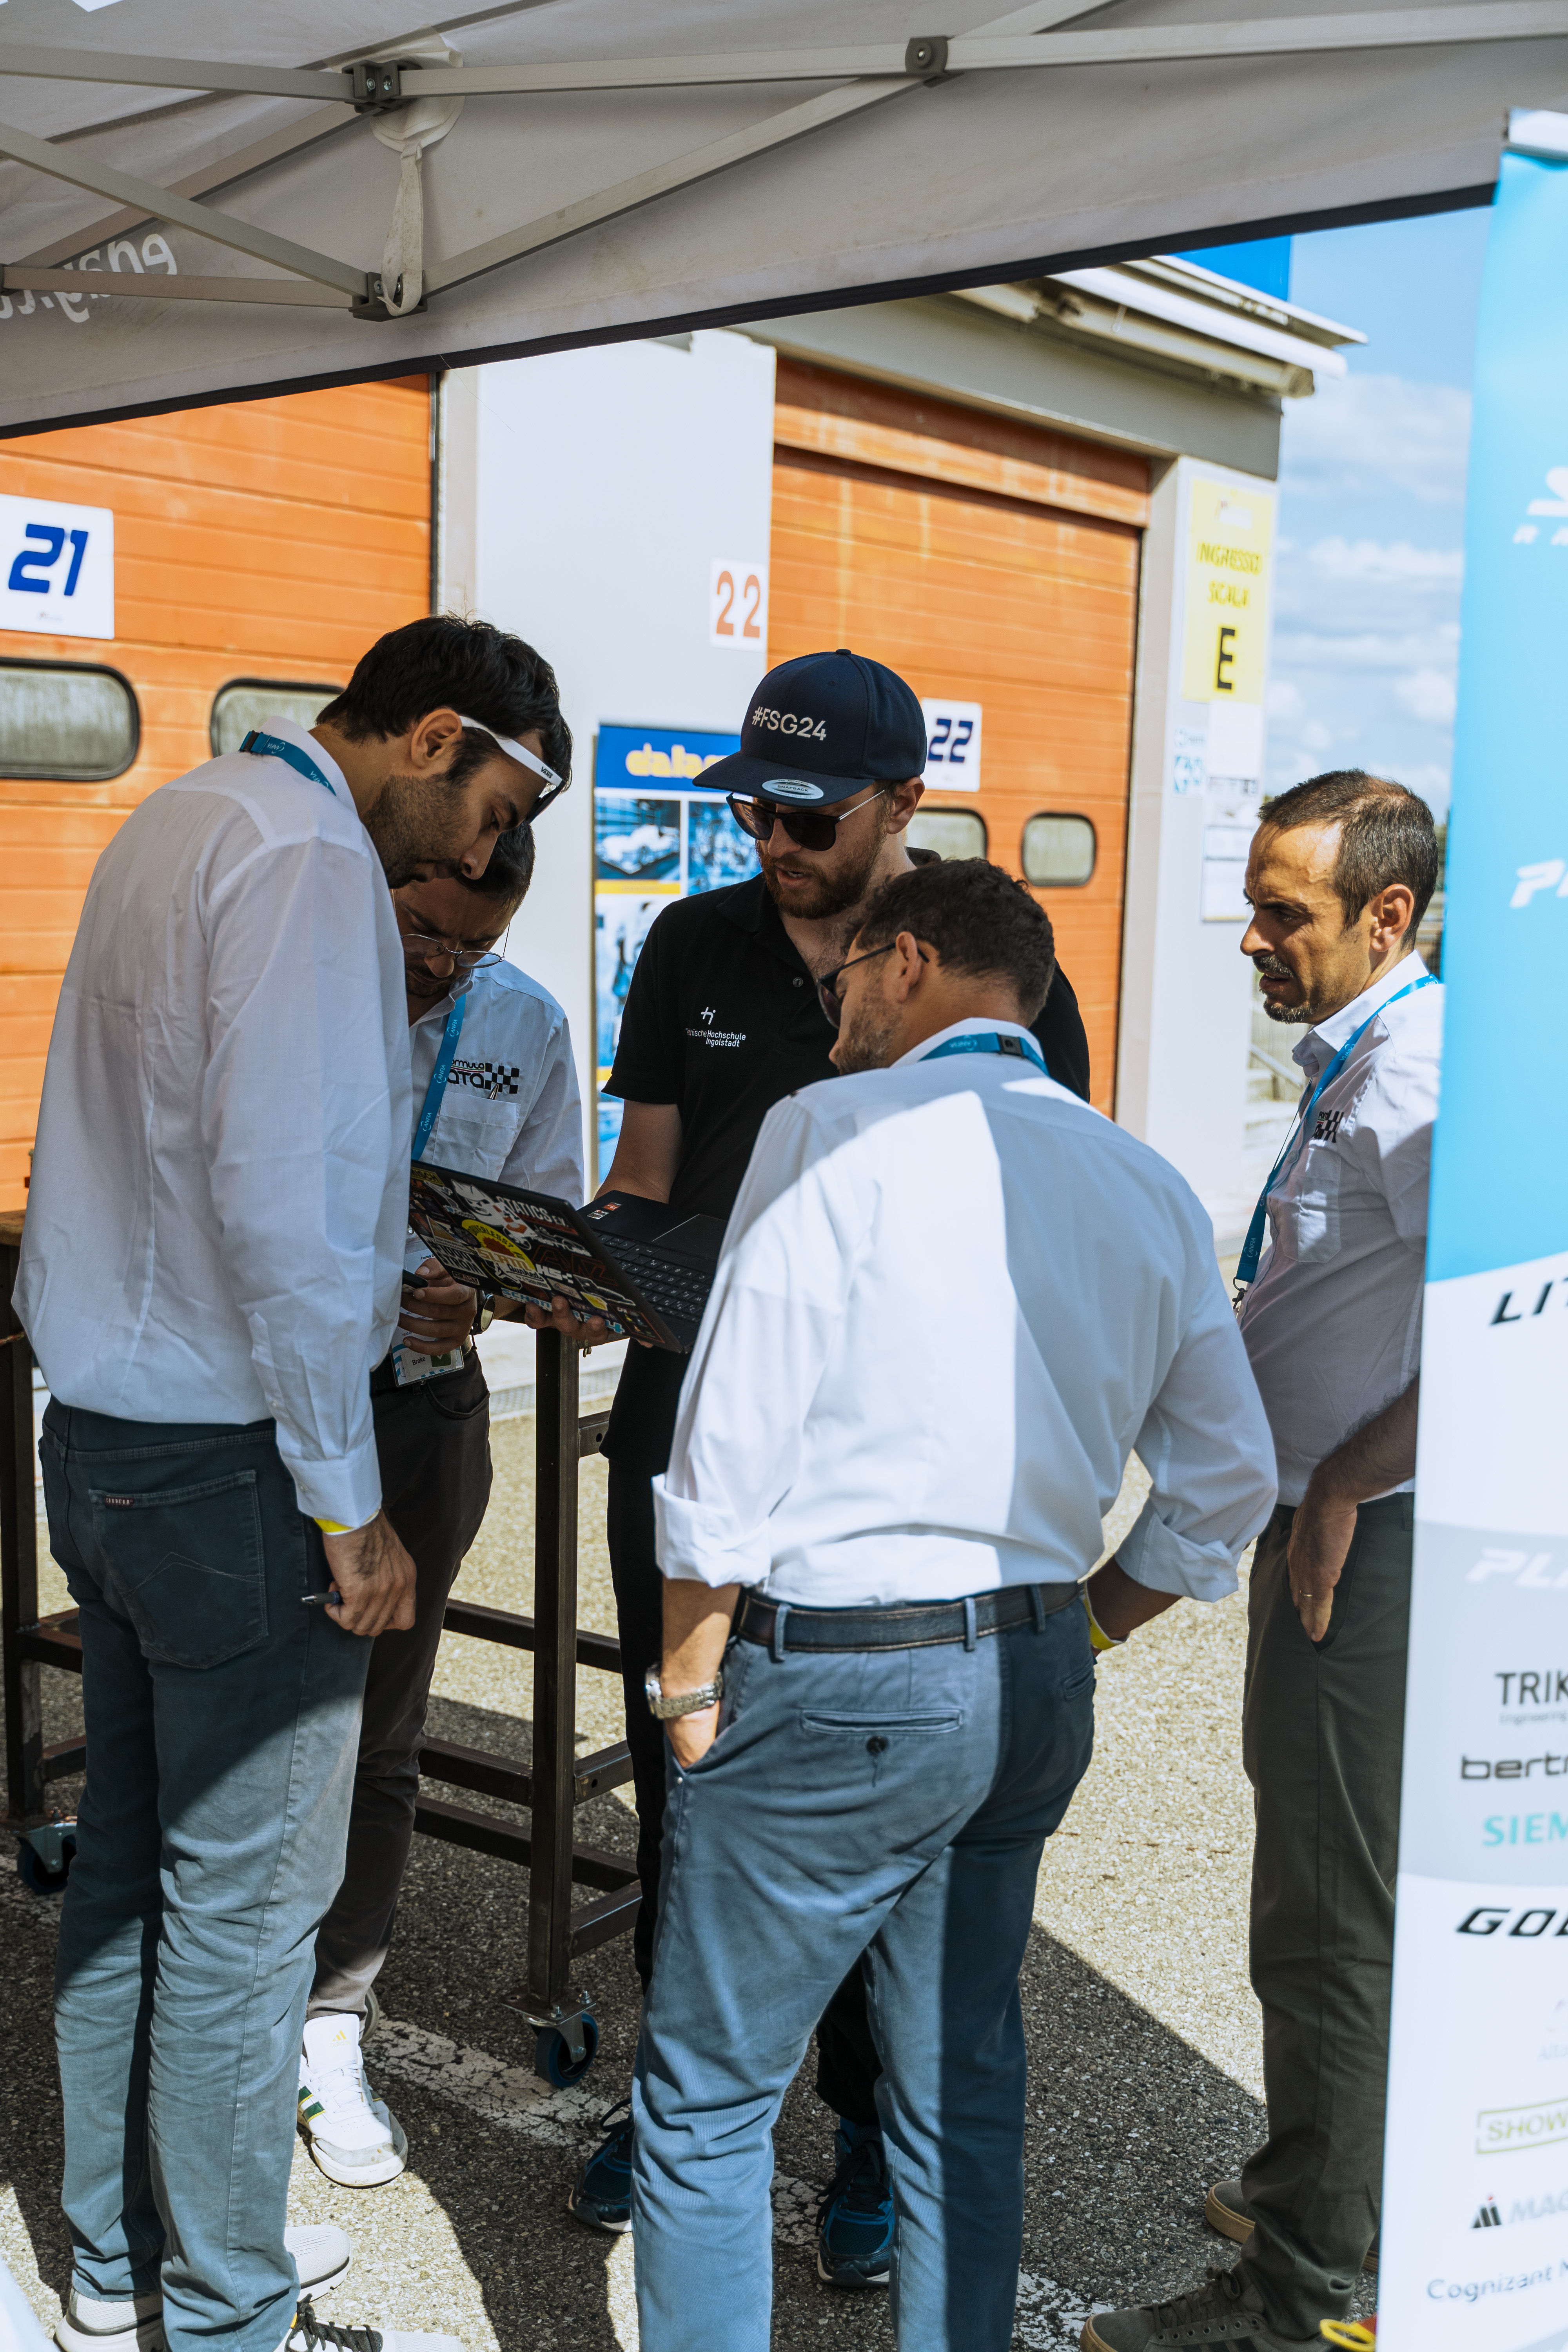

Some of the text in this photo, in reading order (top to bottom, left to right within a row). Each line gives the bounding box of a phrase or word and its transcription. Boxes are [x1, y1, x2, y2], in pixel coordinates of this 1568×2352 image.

[9, 523, 89, 597] 21
[1196, 541, 1263, 575] INGRESSO
[716, 570, 761, 639] 22
[1216, 626, 1236, 691] E
[752, 706, 827, 741] #FSG24
[928, 718, 974, 763] 22
[541, 766, 553, 779] VANS
[706, 1038, 740, 1047] Ingolstadt
[707, 1030, 746, 1040] Hochschule
[451, 1059, 485, 1069] ormula
[436, 1252, 484, 1275] STROM
[412, 1356, 426, 1366] Brake
[1426, 2264, 1552, 2303] Cognizant
